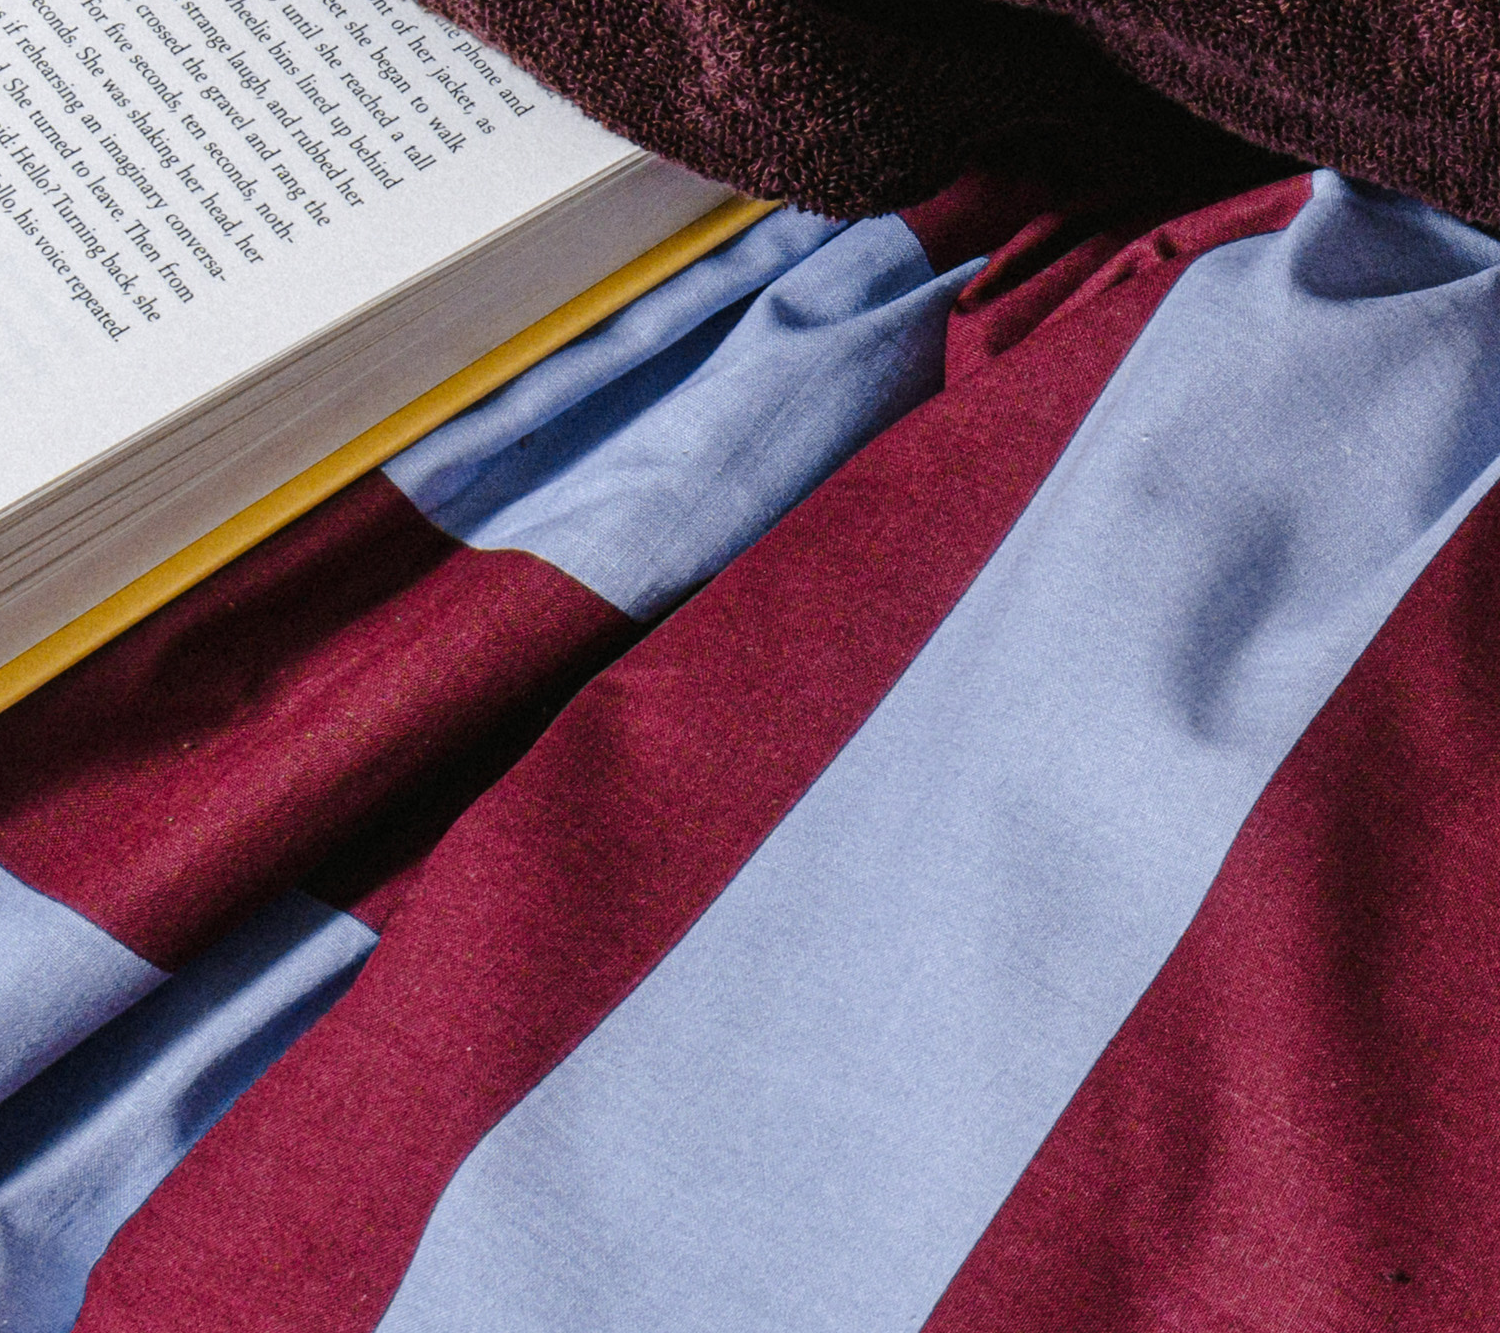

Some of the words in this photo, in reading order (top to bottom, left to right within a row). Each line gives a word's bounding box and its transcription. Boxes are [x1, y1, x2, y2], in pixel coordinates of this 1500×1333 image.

[1, 18, 30, 37] if
[14, 36, 86, 116] rehearsing
[280, 2, 325, 42] until
[313, 42, 344, 70] she
[338, 70, 402, 130] reached
[389, 130, 406, 144] a
[402, 143, 439, 173] tall
[389, 18, 420, 38] of
[406, 33, 438, 65] her
[424, 64, 477, 116] jacket,
[474, 116, 497, 136] as
[450, 31, 502, 87] phone
[497, 87, 536, 118] and
[79, 113, 104, 136] an
[134, 3, 194, 58] crossed
[180, 55, 210, 84] the
[198, 84, 257, 132] gravel
[243, 131, 283, 163] and
[269, 162, 308, 203] rang
[302, 198, 332, 228] the
[98, 132, 170, 211] imaginary
[163, 212, 227, 283] conversa-
